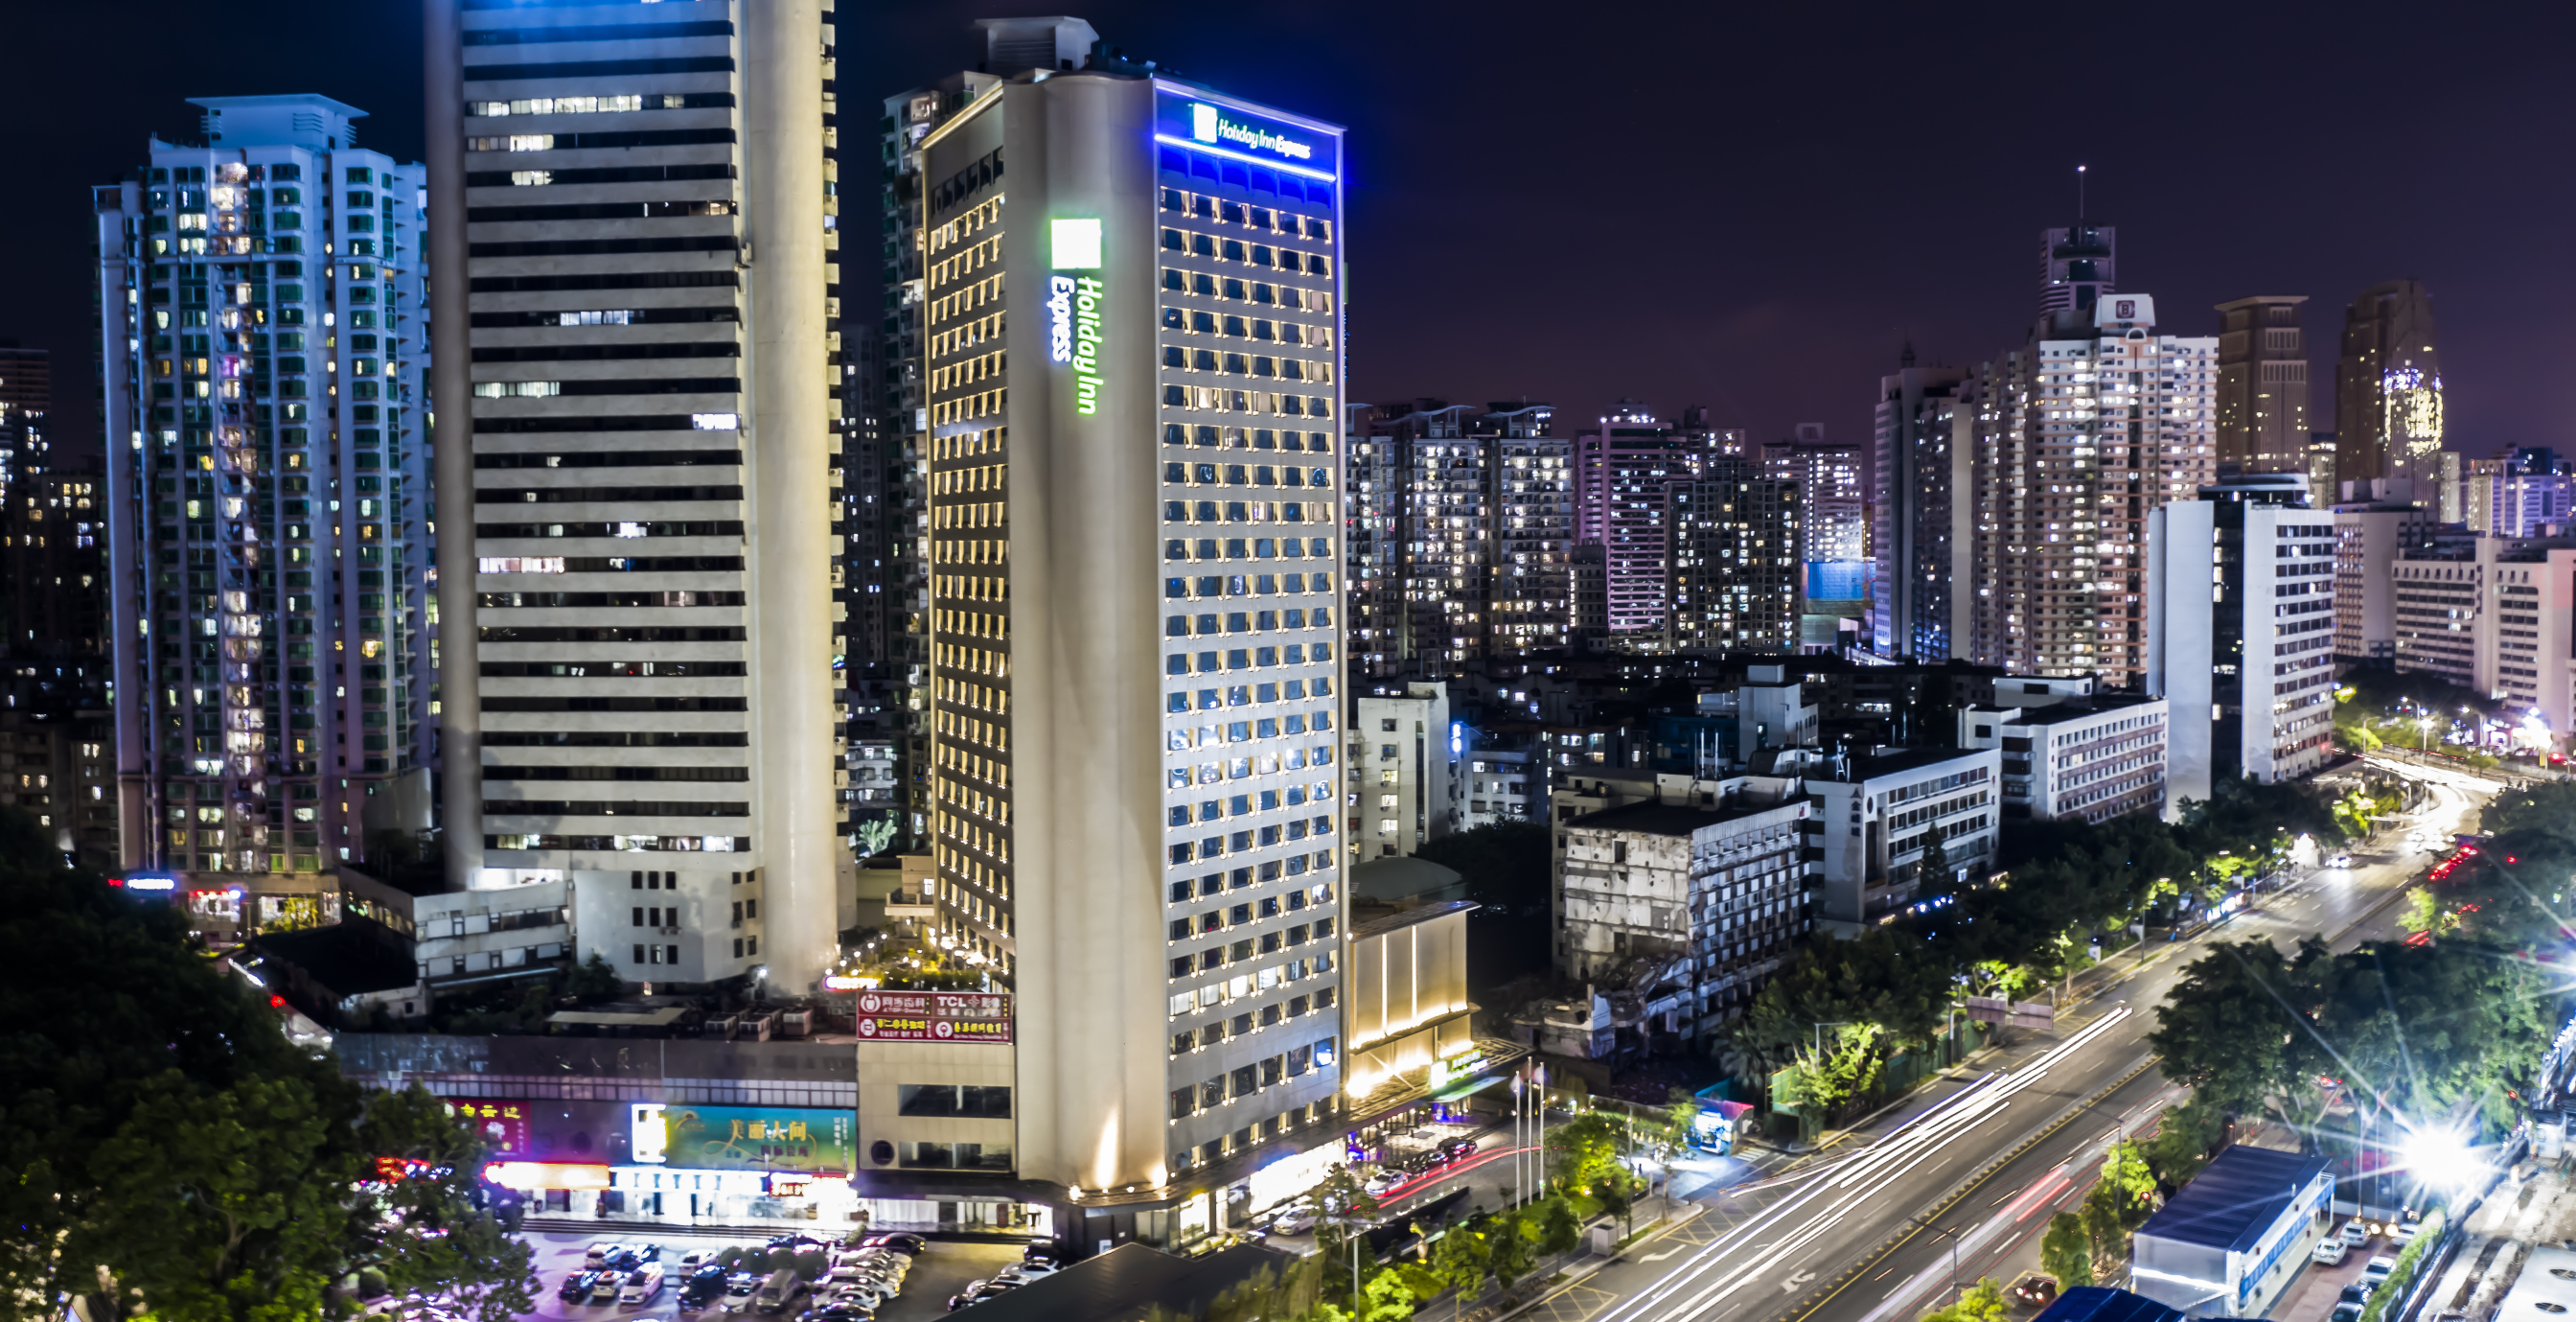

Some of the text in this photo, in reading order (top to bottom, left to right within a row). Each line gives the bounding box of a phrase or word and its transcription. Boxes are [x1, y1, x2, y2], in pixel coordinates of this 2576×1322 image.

[1218, 118, 1258, 149] Holiday
[1258, 129, 1276, 150] Inn
[1046, 276, 1074, 361] Express
[1072, 276, 1104, 414] Holiday Inn
[937, 996, 967, 1008] TCL
